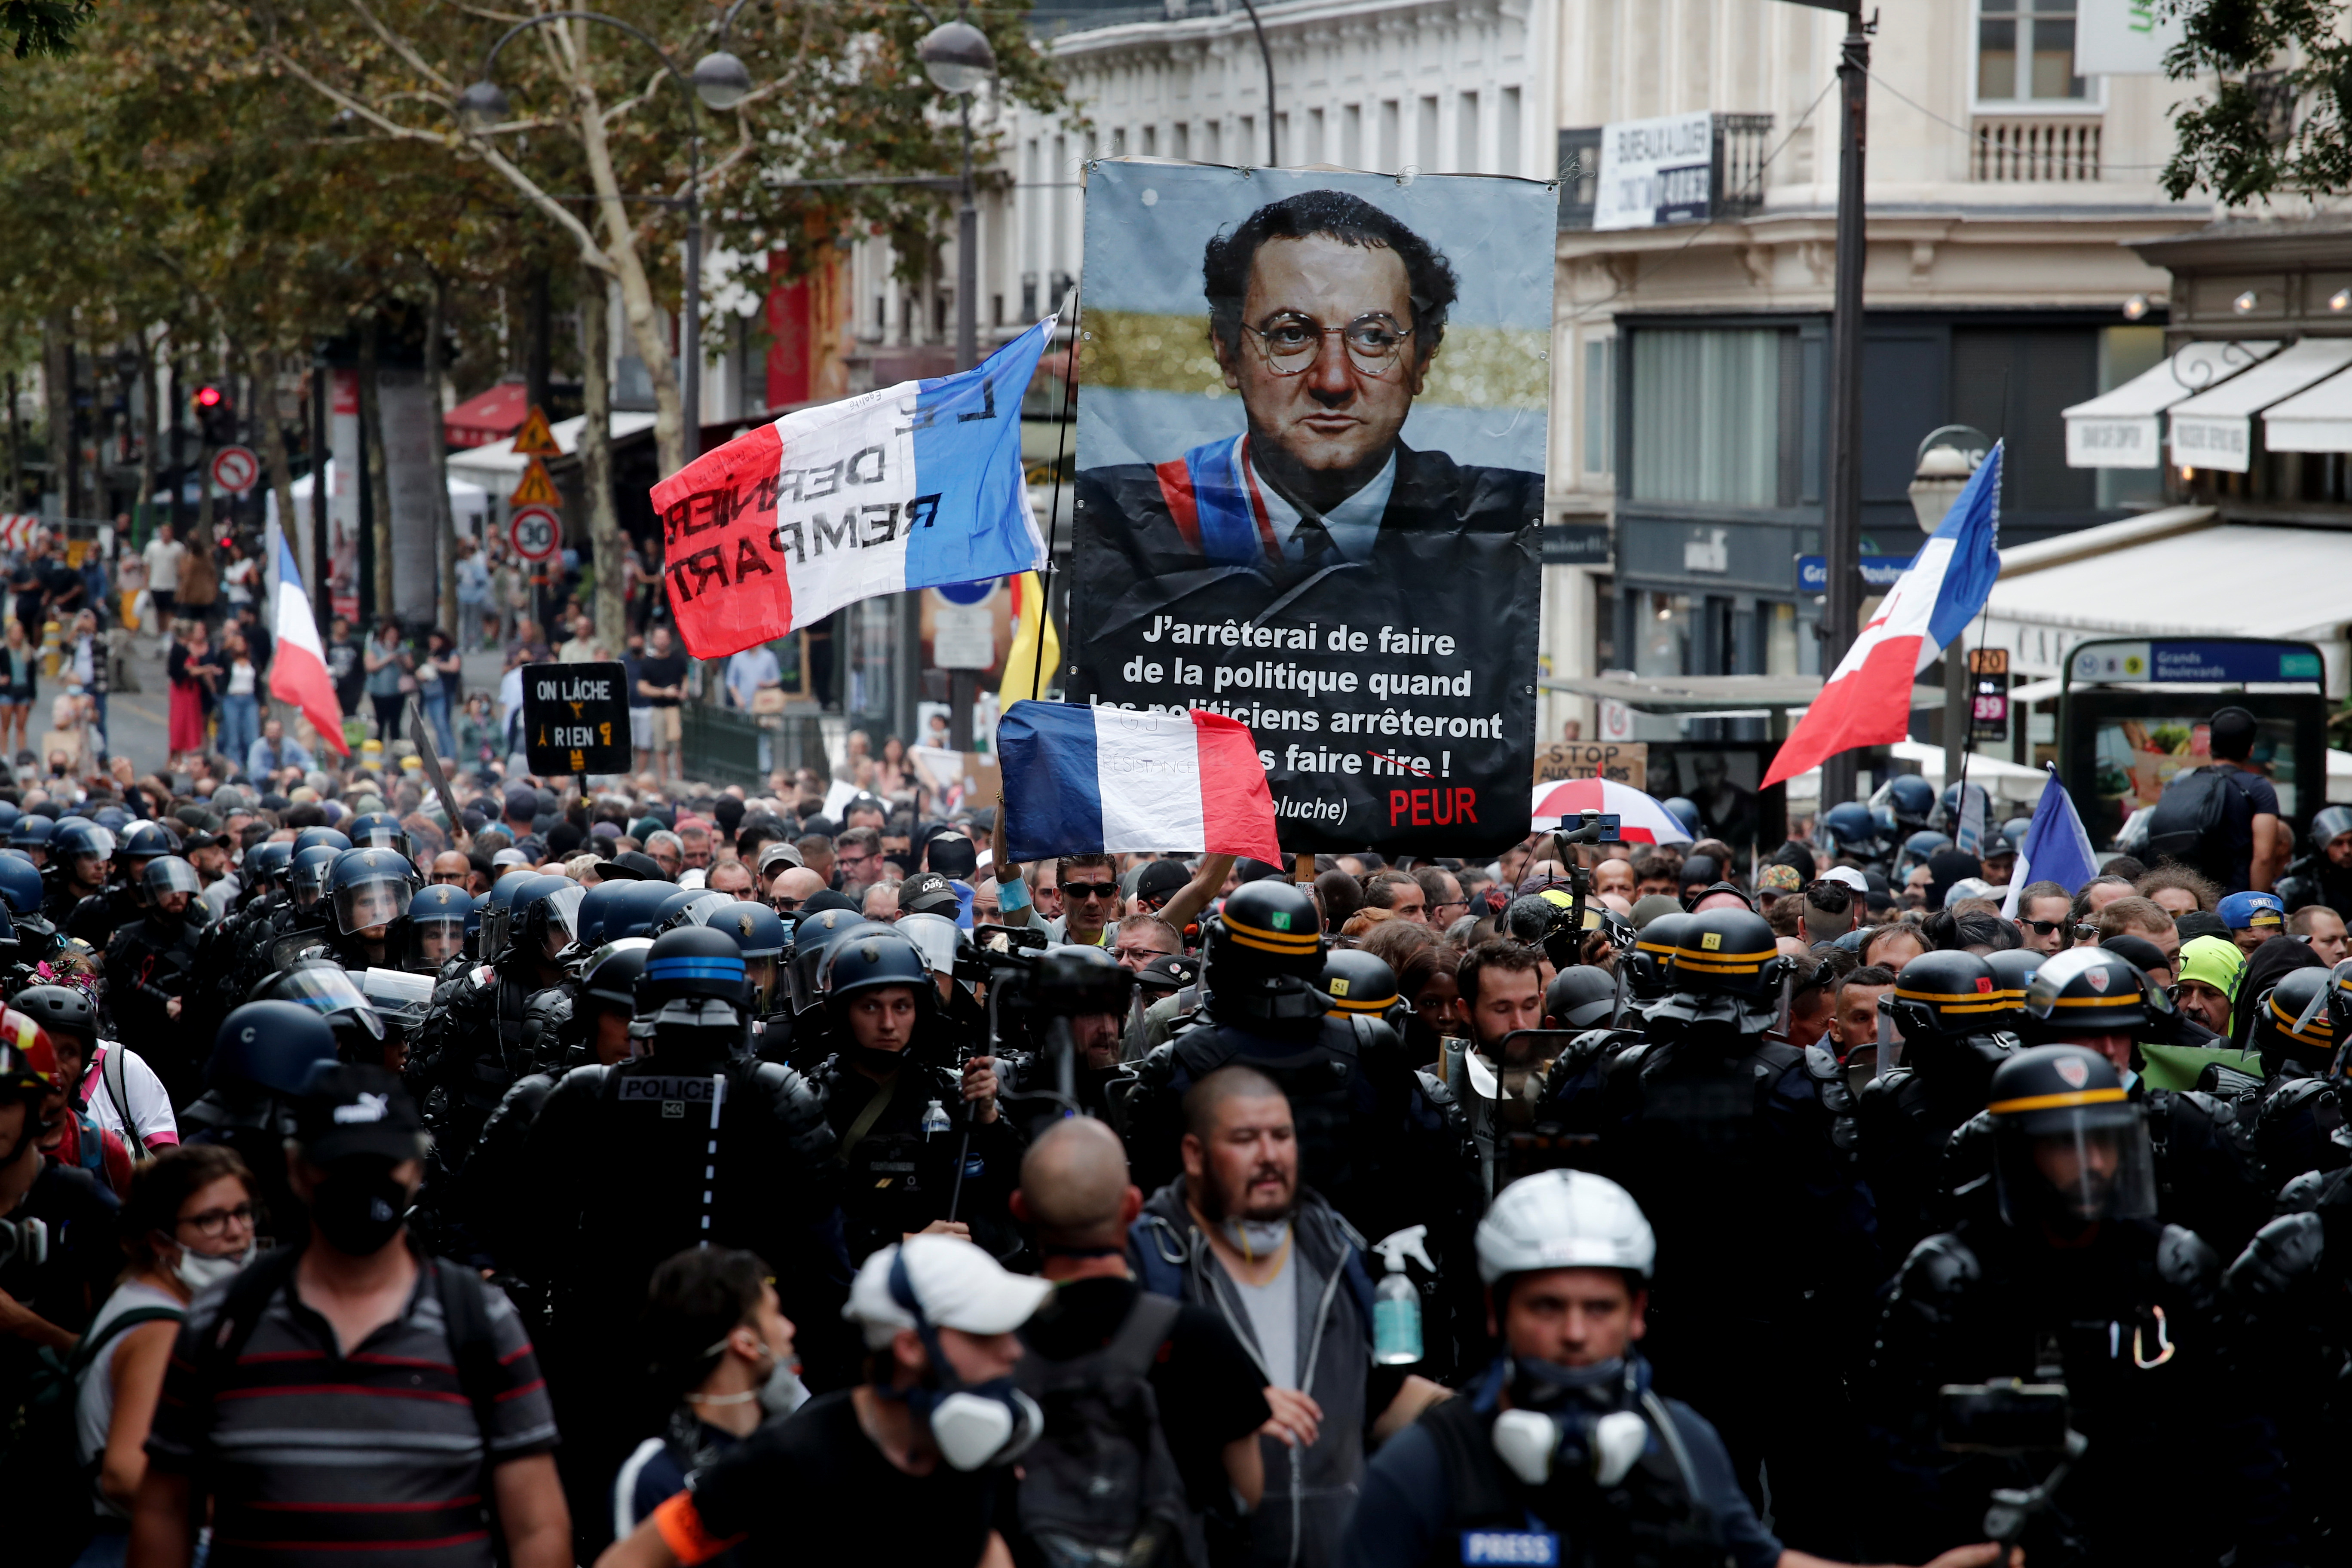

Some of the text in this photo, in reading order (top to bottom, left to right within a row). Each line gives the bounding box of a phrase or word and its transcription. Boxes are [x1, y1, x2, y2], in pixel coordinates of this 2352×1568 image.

[521, 521, 552, 545] 30
[1327, 624, 1369, 652] de
[1378, 625, 1456, 656] faire
[2157, 651, 2202, 665] Grands
[1123, 655, 1472, 701] de la politique quand
[2157, 665, 2226, 678] Boulevards
[537, 676, 611, 701] ON LÂCHE
[1975, 696, 2003, 719] 39
[1330, 707, 1503, 739] arrêteront
[554, 726, 594, 747] RIEN
[1285, 744, 1362, 775] faire
[1373, 748, 1431, 777] rire
[1550, 744, 1619, 764] STOP
[1538, 766, 1571, 780] AUX
[1389, 787, 1478, 827] PEUR
[922, 880, 943, 892] Dafy
[1706, 937, 1717, 945] 51
[1334, 983, 1344, 992] 51
[241, 1026, 256, 1044] C
[626, 1079, 715, 1099] POLICE
[1468, 1532, 1551, 1563] PRESS
